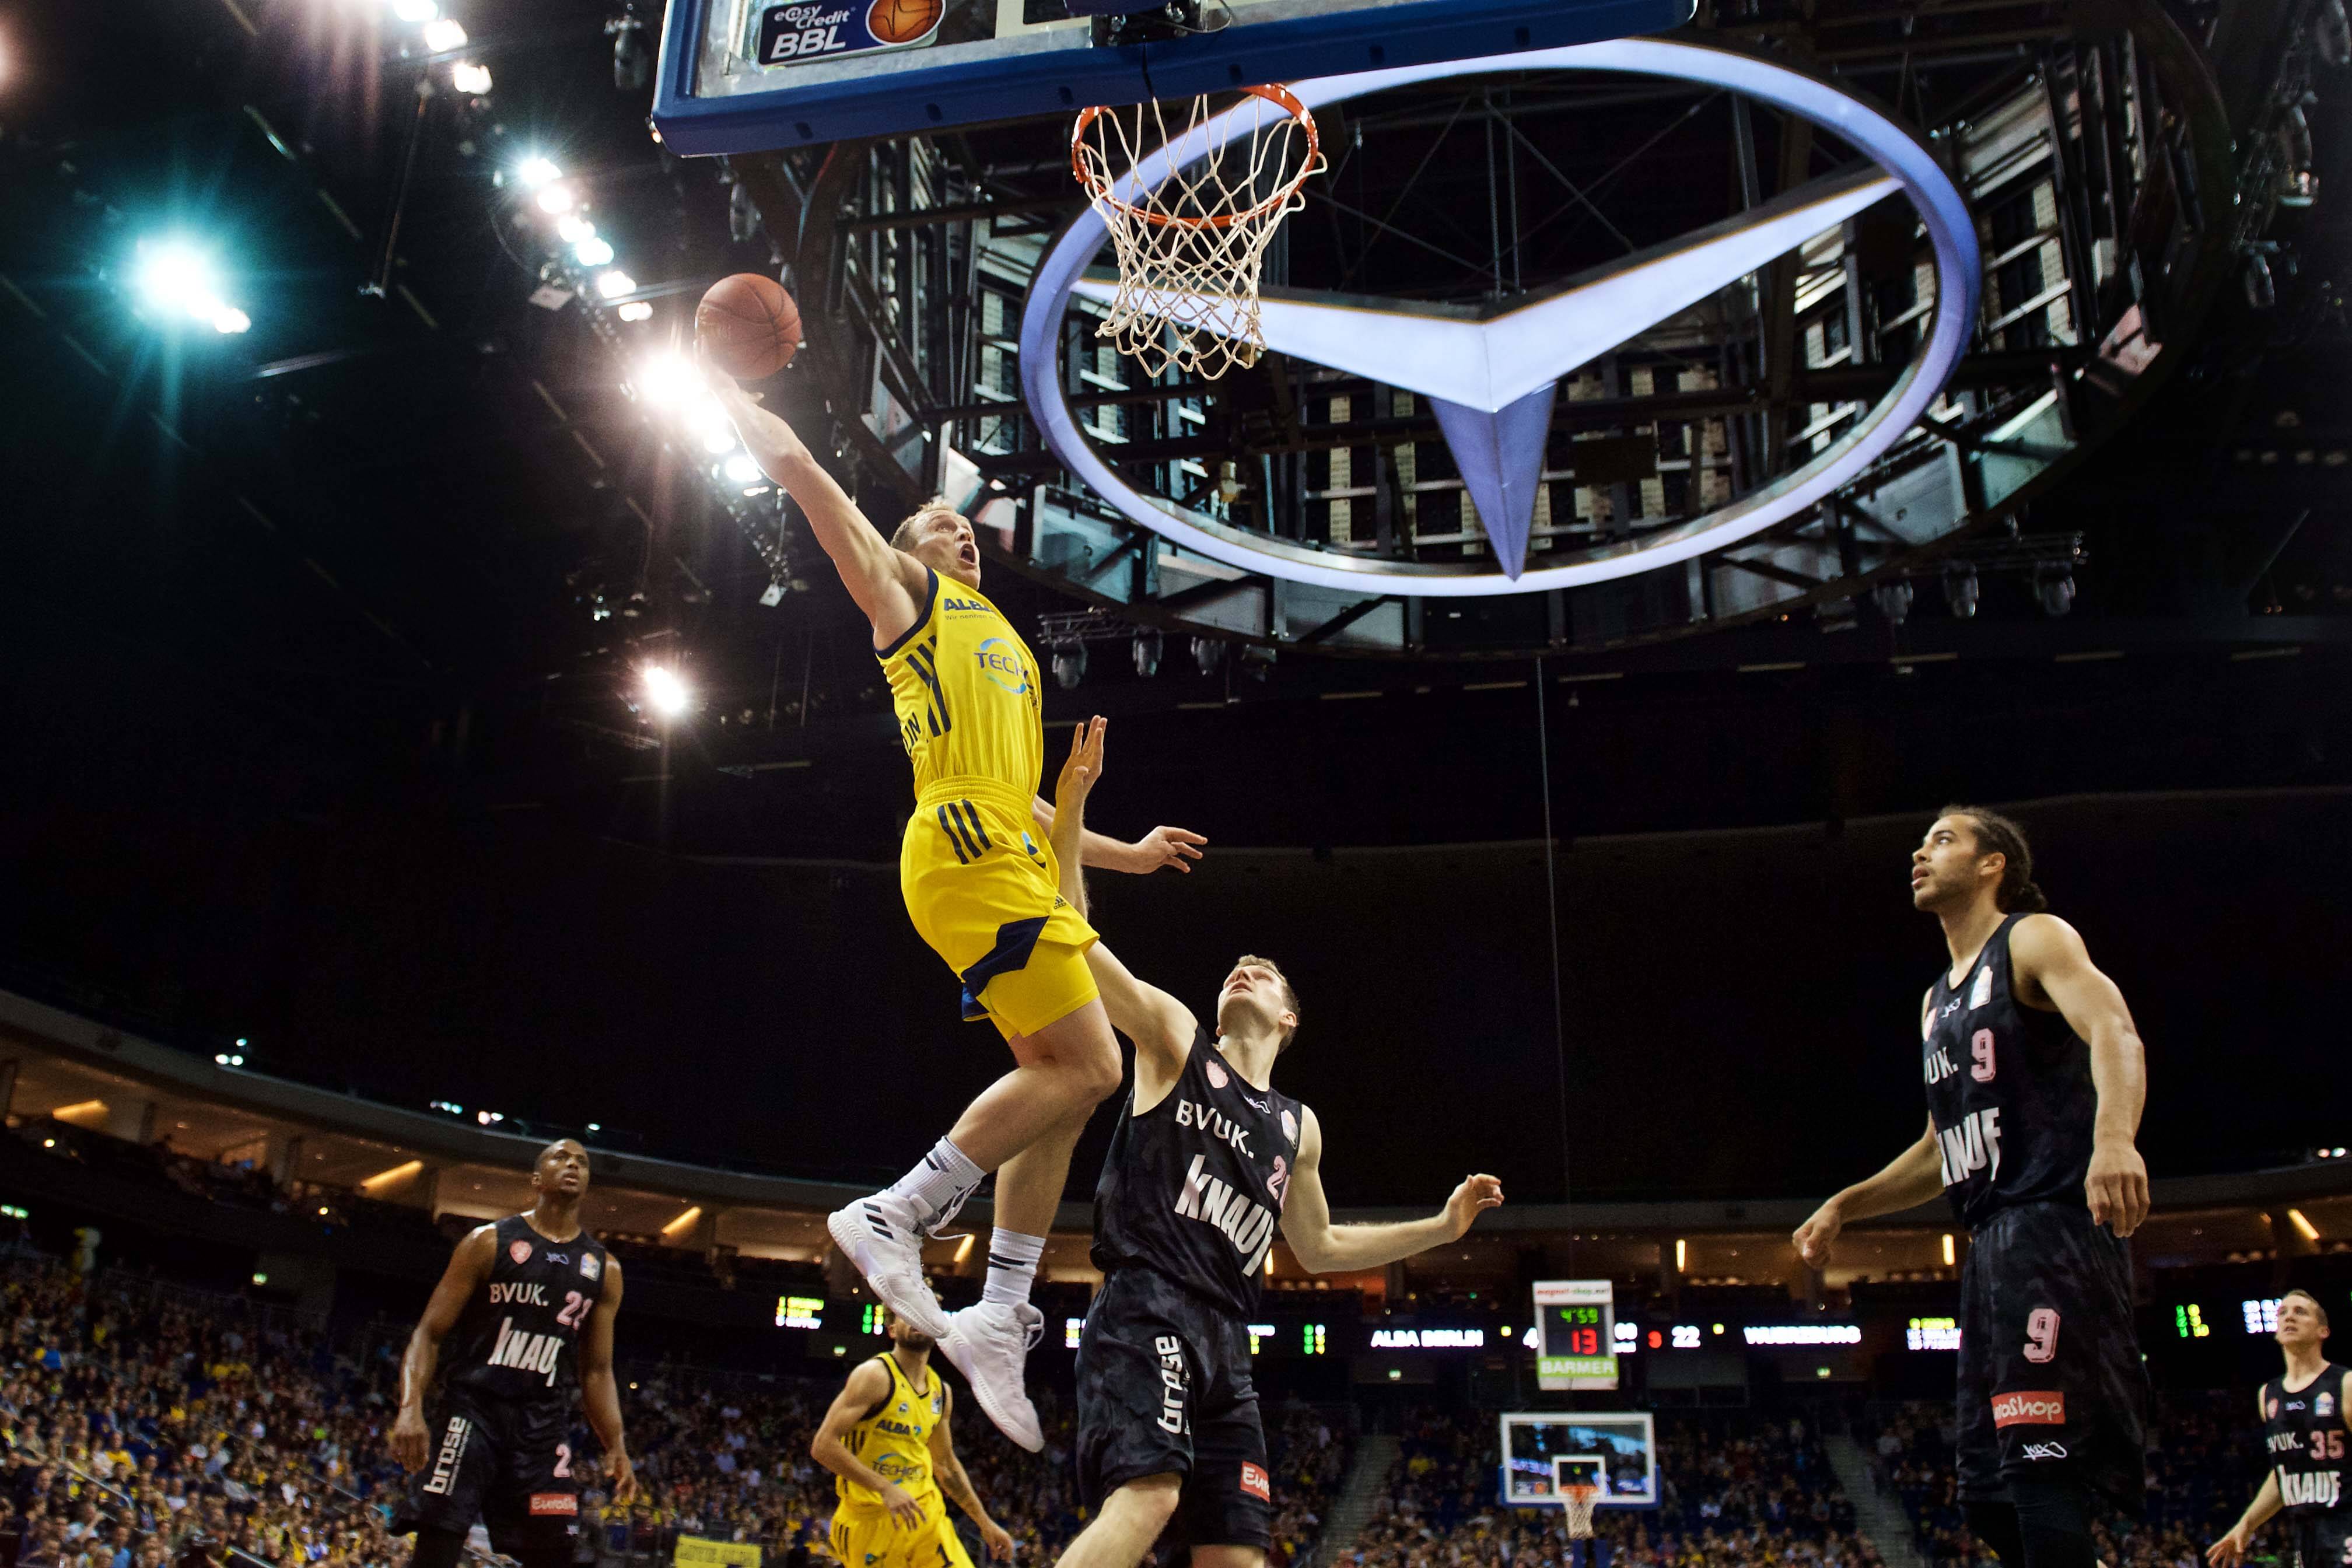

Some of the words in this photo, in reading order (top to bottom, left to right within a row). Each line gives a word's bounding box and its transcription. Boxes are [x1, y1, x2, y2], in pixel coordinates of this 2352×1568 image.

[770, 26, 846, 59] BBL
[1971, 1028, 1996, 1082] 9
[1175, 1099, 1254, 1159] BVUK.
[490, 1283, 549, 1307] BVUK.
[1572, 1328, 1598, 1355] 13
[2023, 1308, 2060, 1363] 9
[1541, 1360, 1615, 1375] BARMER
[1155, 1336, 1183, 1434] brose
[876, 1419, 910, 1436] ALBA
[422, 1416, 467, 1494] brose
[2310, 1430, 2345, 1461] 35
